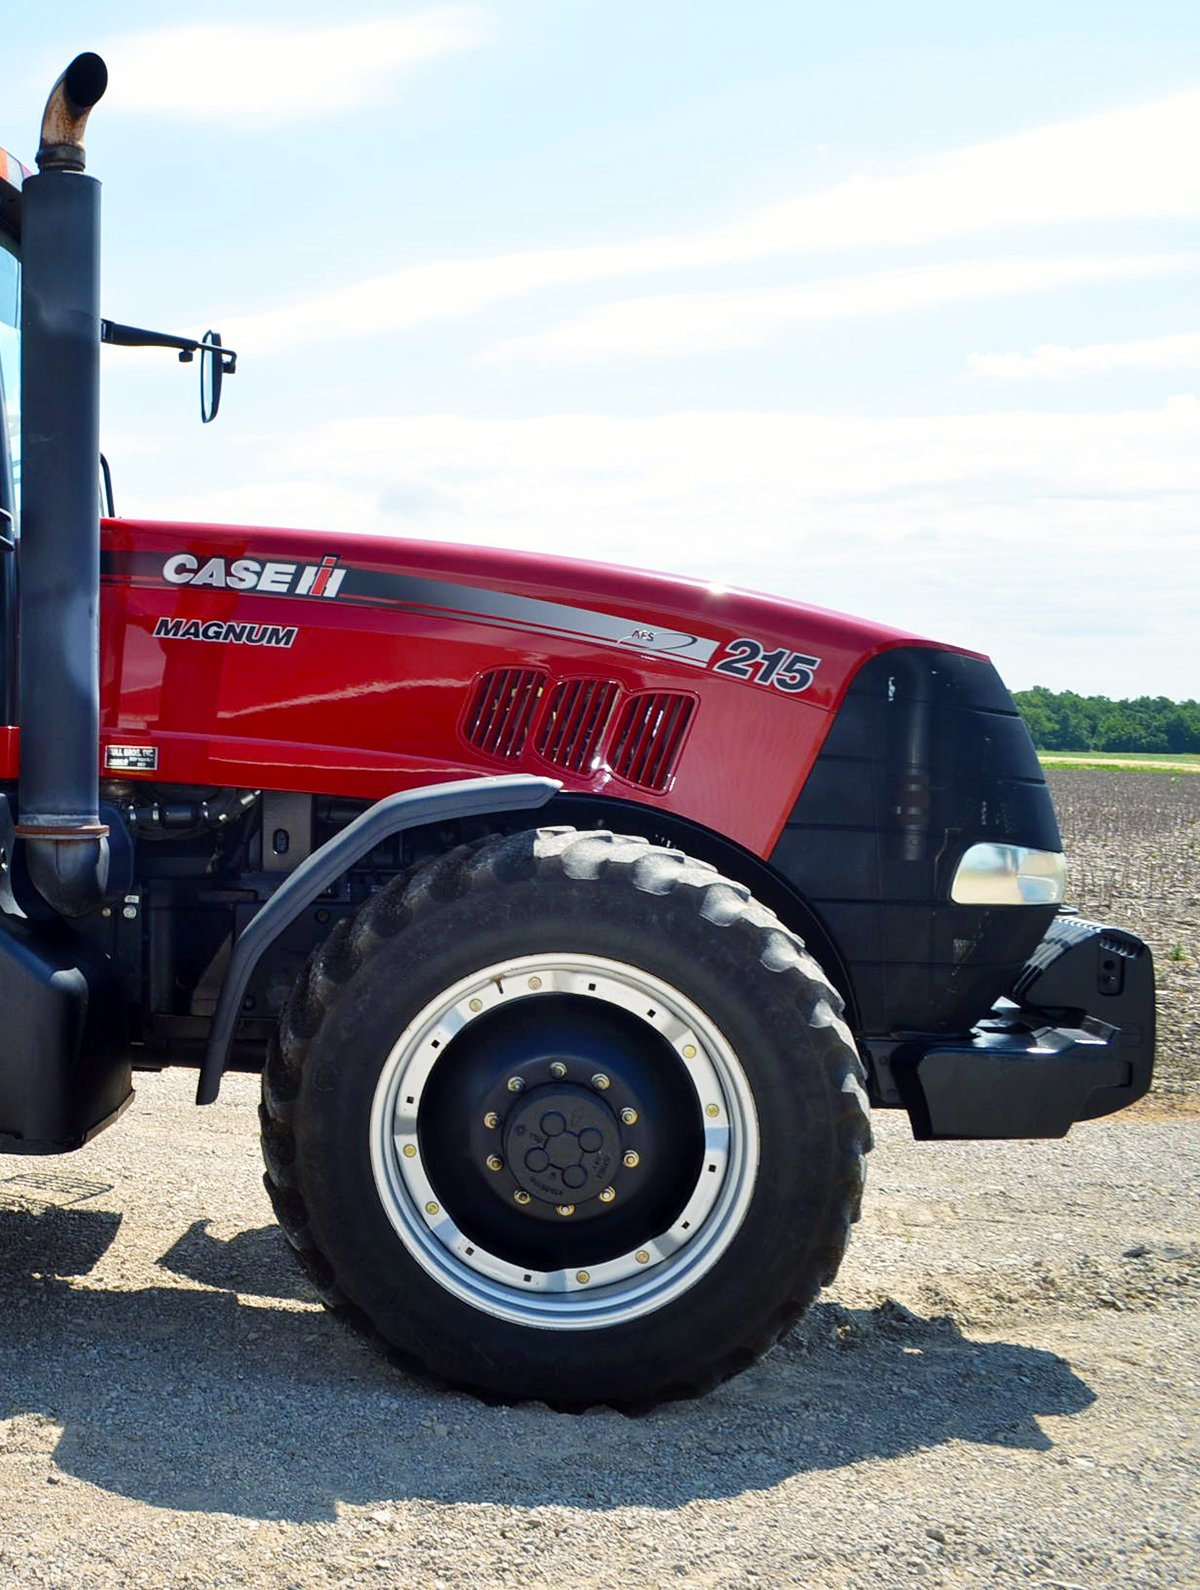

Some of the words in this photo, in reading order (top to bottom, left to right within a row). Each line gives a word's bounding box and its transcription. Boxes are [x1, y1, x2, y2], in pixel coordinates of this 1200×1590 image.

[163, 554, 297, 593] CASE
[153, 617, 298, 648] MAGNUM
[631, 628, 655, 642] AFS
[713, 638, 821, 693] 215
